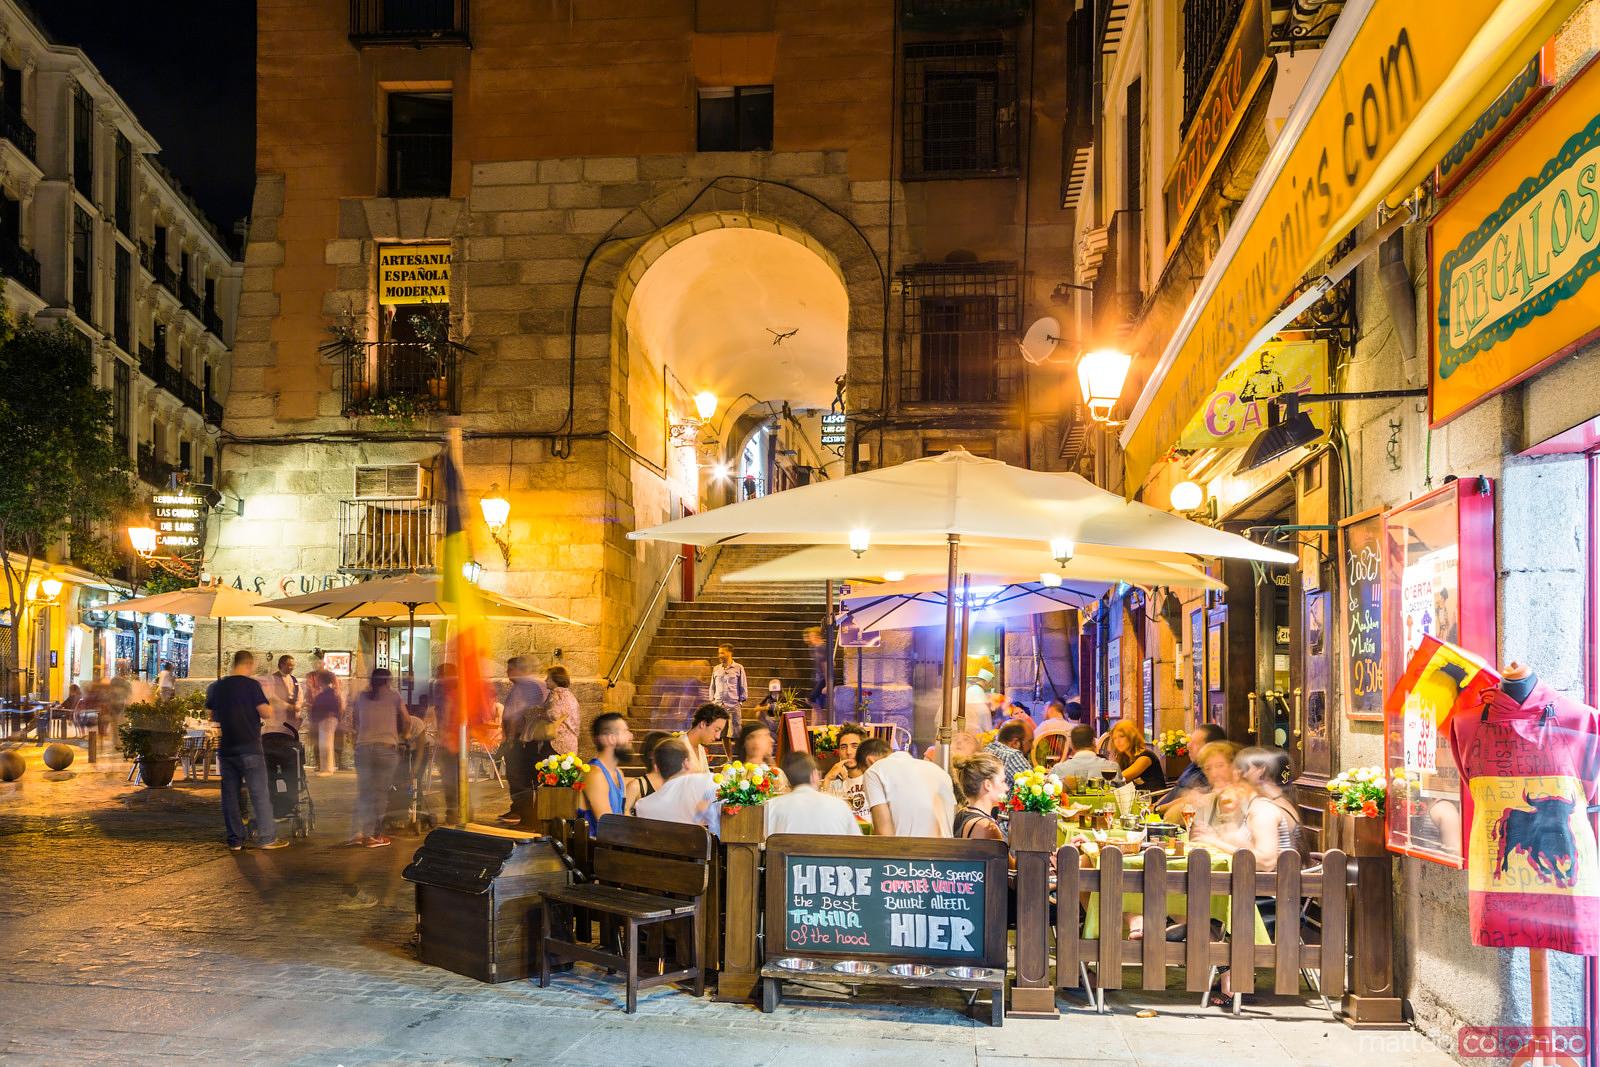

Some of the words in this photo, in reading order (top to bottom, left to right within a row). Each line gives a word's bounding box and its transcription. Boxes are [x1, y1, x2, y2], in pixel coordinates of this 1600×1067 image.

[1452, 163, 1600, 341] REGALOS
[381, 255, 451, 266] ARTESANIA
[385, 267, 449, 281] ESPAÑOLA
[386, 286, 446, 297] MODERNA
[157, 508, 171, 517] LAS
[882, 864, 908, 877] De
[909, 862, 944, 879] beste
[793, 865, 872, 896] HERE
[794, 895, 813, 907] the
[820, 897, 861, 911] Best
[811, 928, 831, 943] the
[835, 929, 870, 946] hood
[890, 913, 975, 952] HIER
